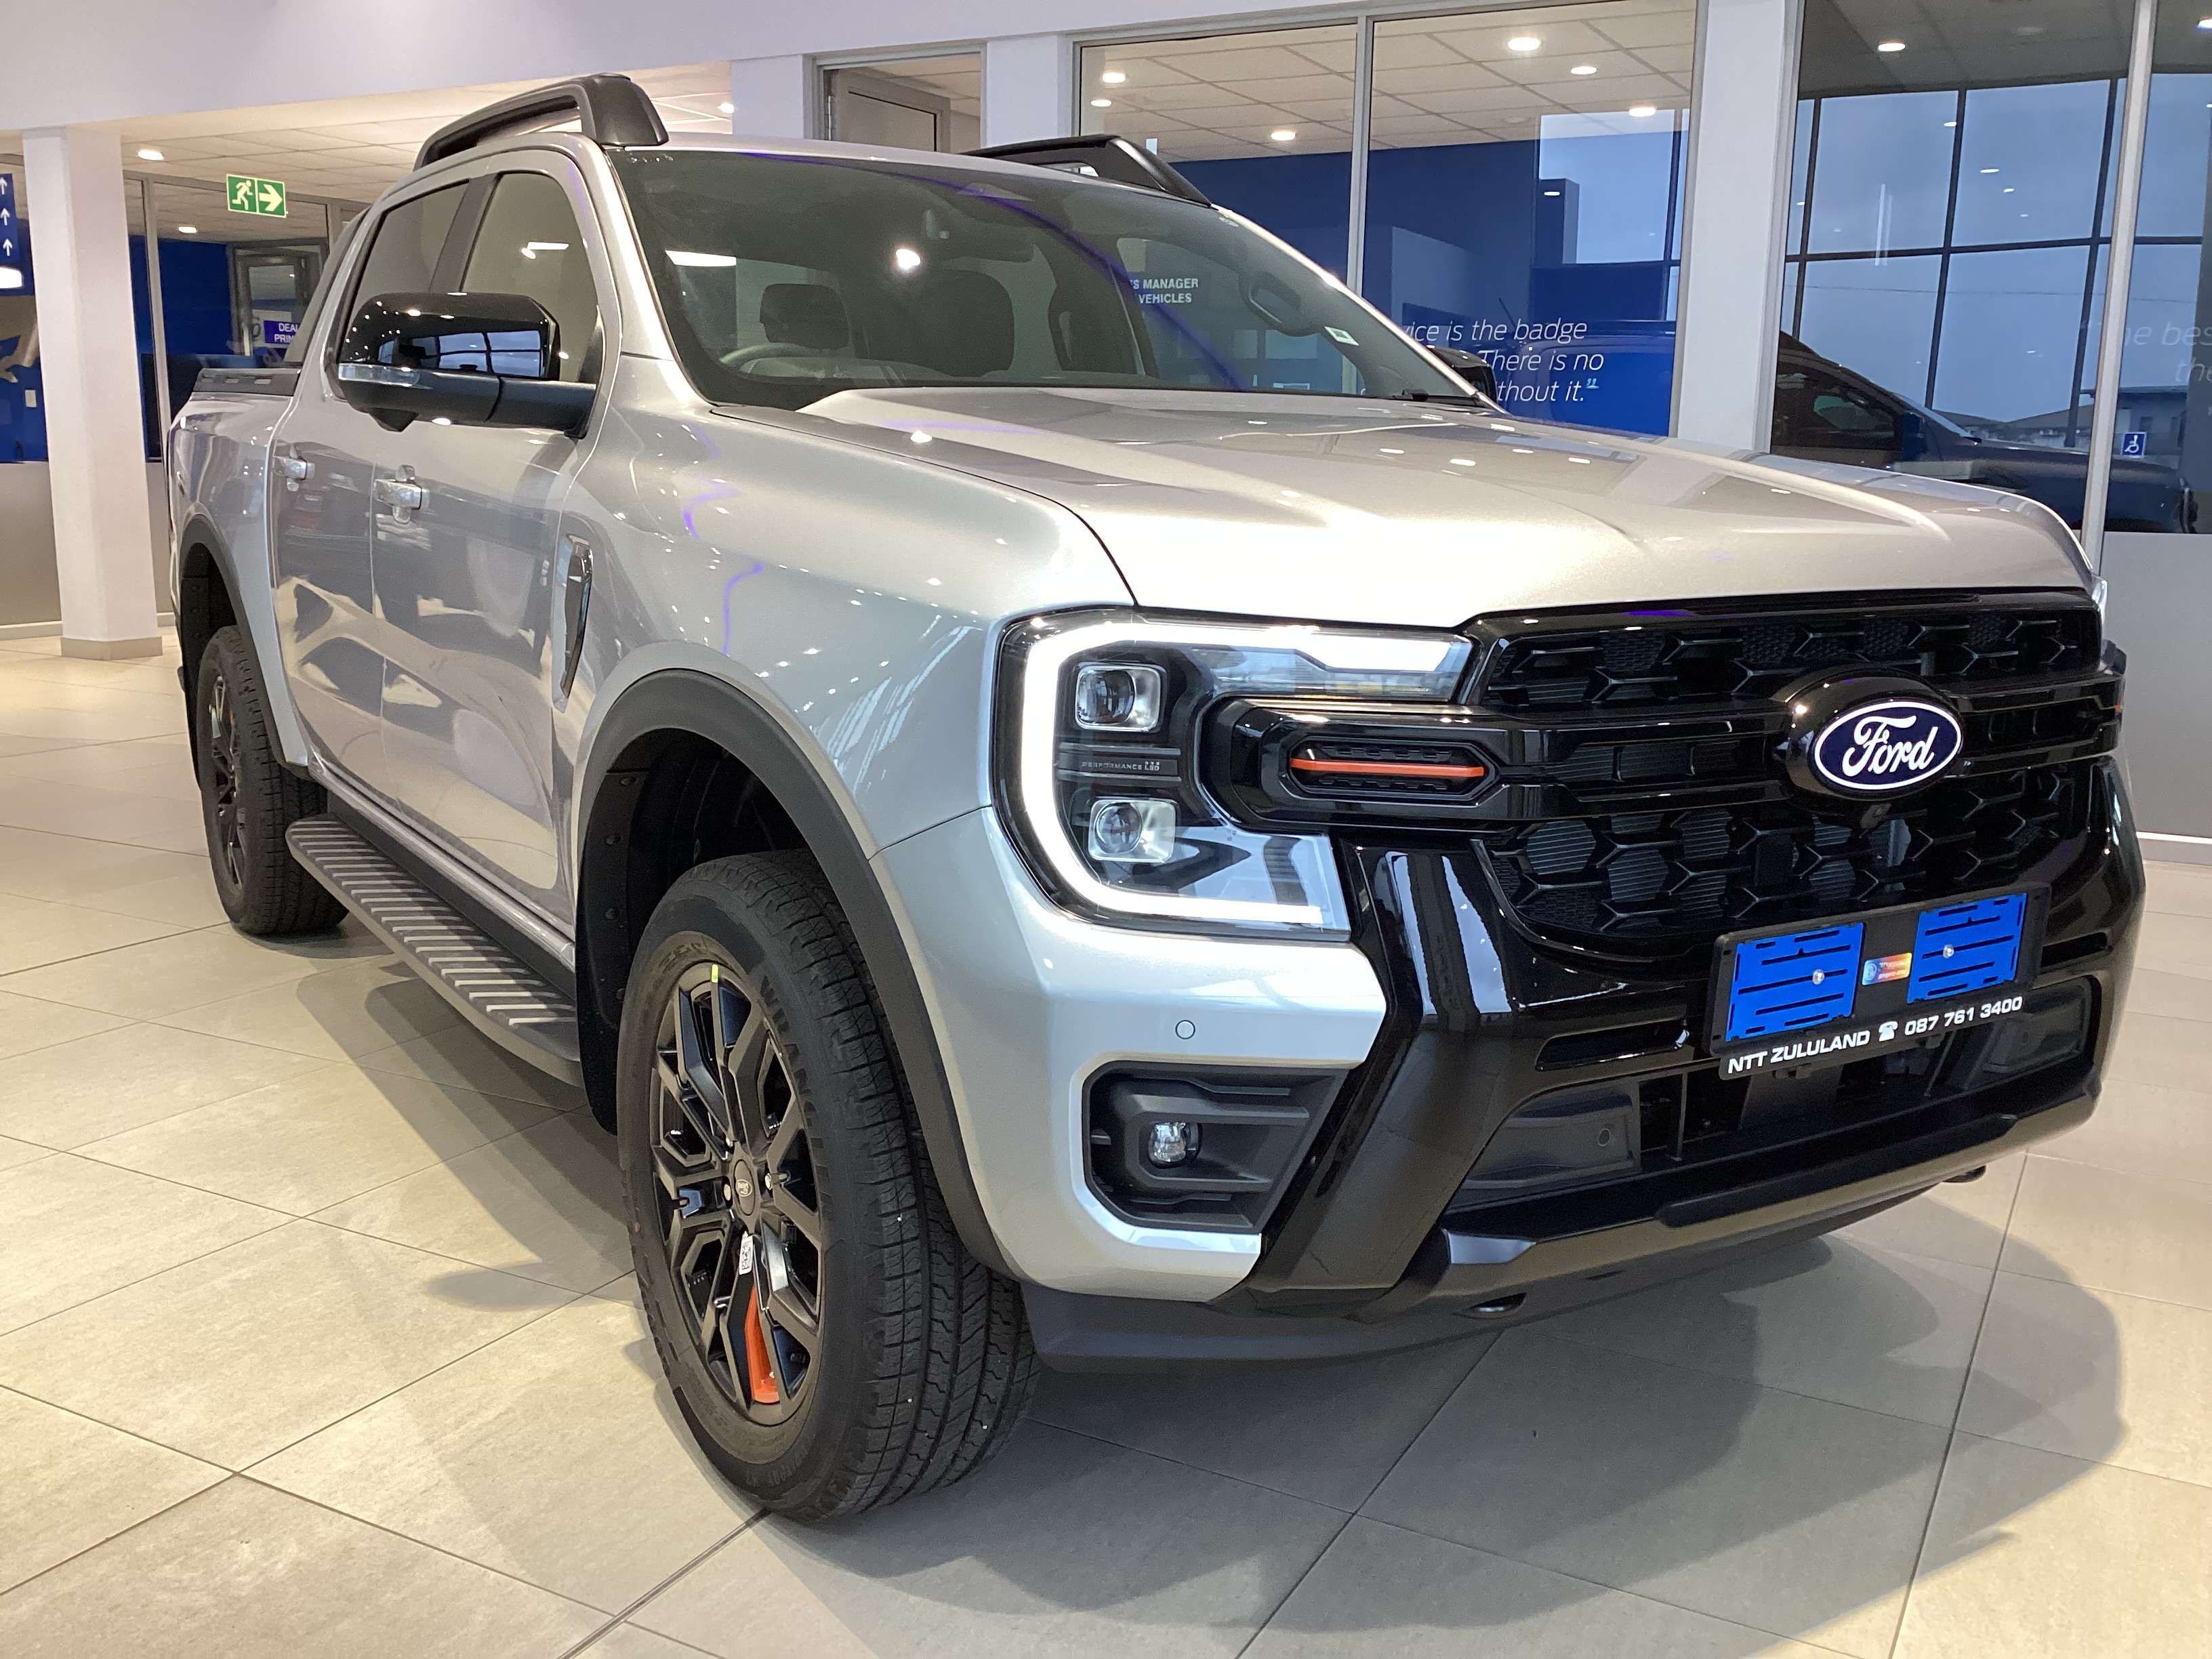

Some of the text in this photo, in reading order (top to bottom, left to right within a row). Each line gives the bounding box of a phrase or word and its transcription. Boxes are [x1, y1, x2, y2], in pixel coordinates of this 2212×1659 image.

[1143, 278, 1198, 289] MANAGER
[1139, 293, 1192, 304] VEHICLES
[1446, 321, 1464, 341] is
[1471, 319, 1507, 341] the
[1513, 317, 1587, 344] badge
[1477, 349, 1604, 371] There is no
[1842, 715, 1939, 777] Ford
[1082, 761, 1143, 771] PERFORMANCE
[1727, 996, 2023, 1074] NTT ZULULAND 087 761 3400
